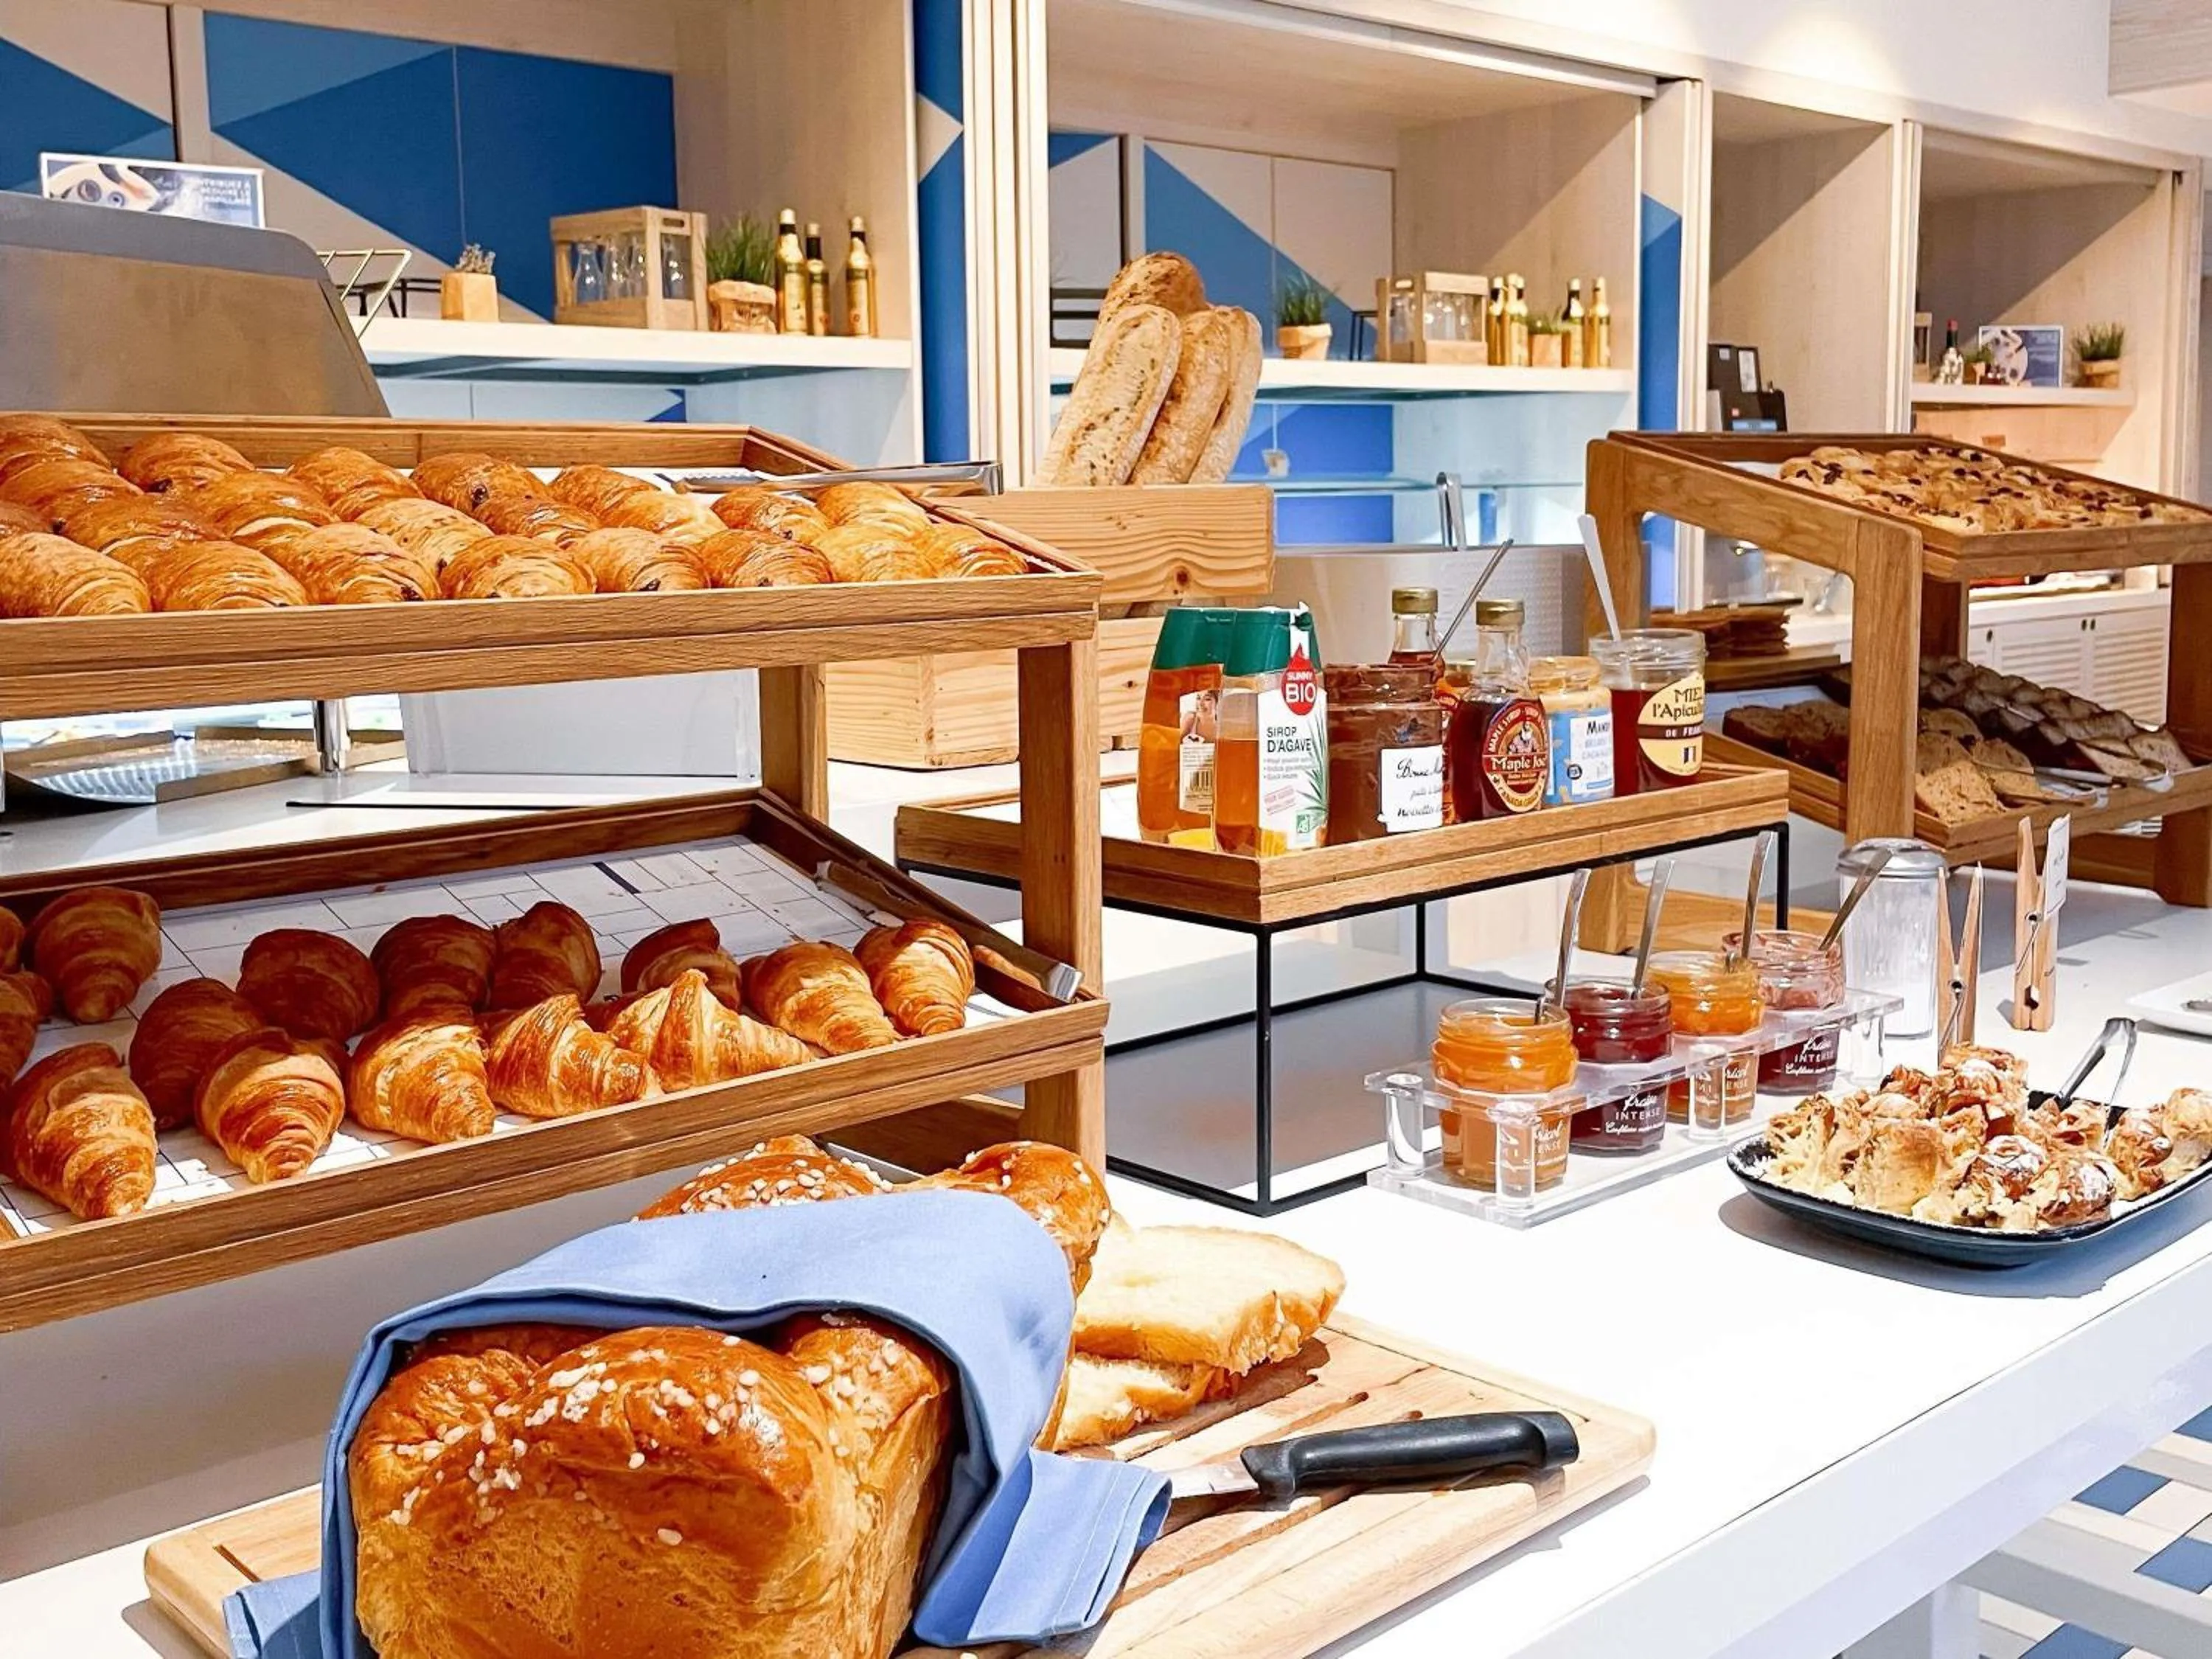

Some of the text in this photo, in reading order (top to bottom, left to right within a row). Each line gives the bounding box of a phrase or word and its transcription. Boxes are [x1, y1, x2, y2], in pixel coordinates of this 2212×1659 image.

[1286, 671, 1312, 681] SUNNY
[1285, 682, 1316, 703] BIO
[1674, 686, 1703, 703] MIE
[1266, 726, 1298, 738] SIROP
[1665, 728, 1677, 737] DE
[1267, 738, 1312, 753] D'AGAVE
[1491, 756, 1531, 773] Maple
[1615, 1107, 1661, 1121] INTENSE
